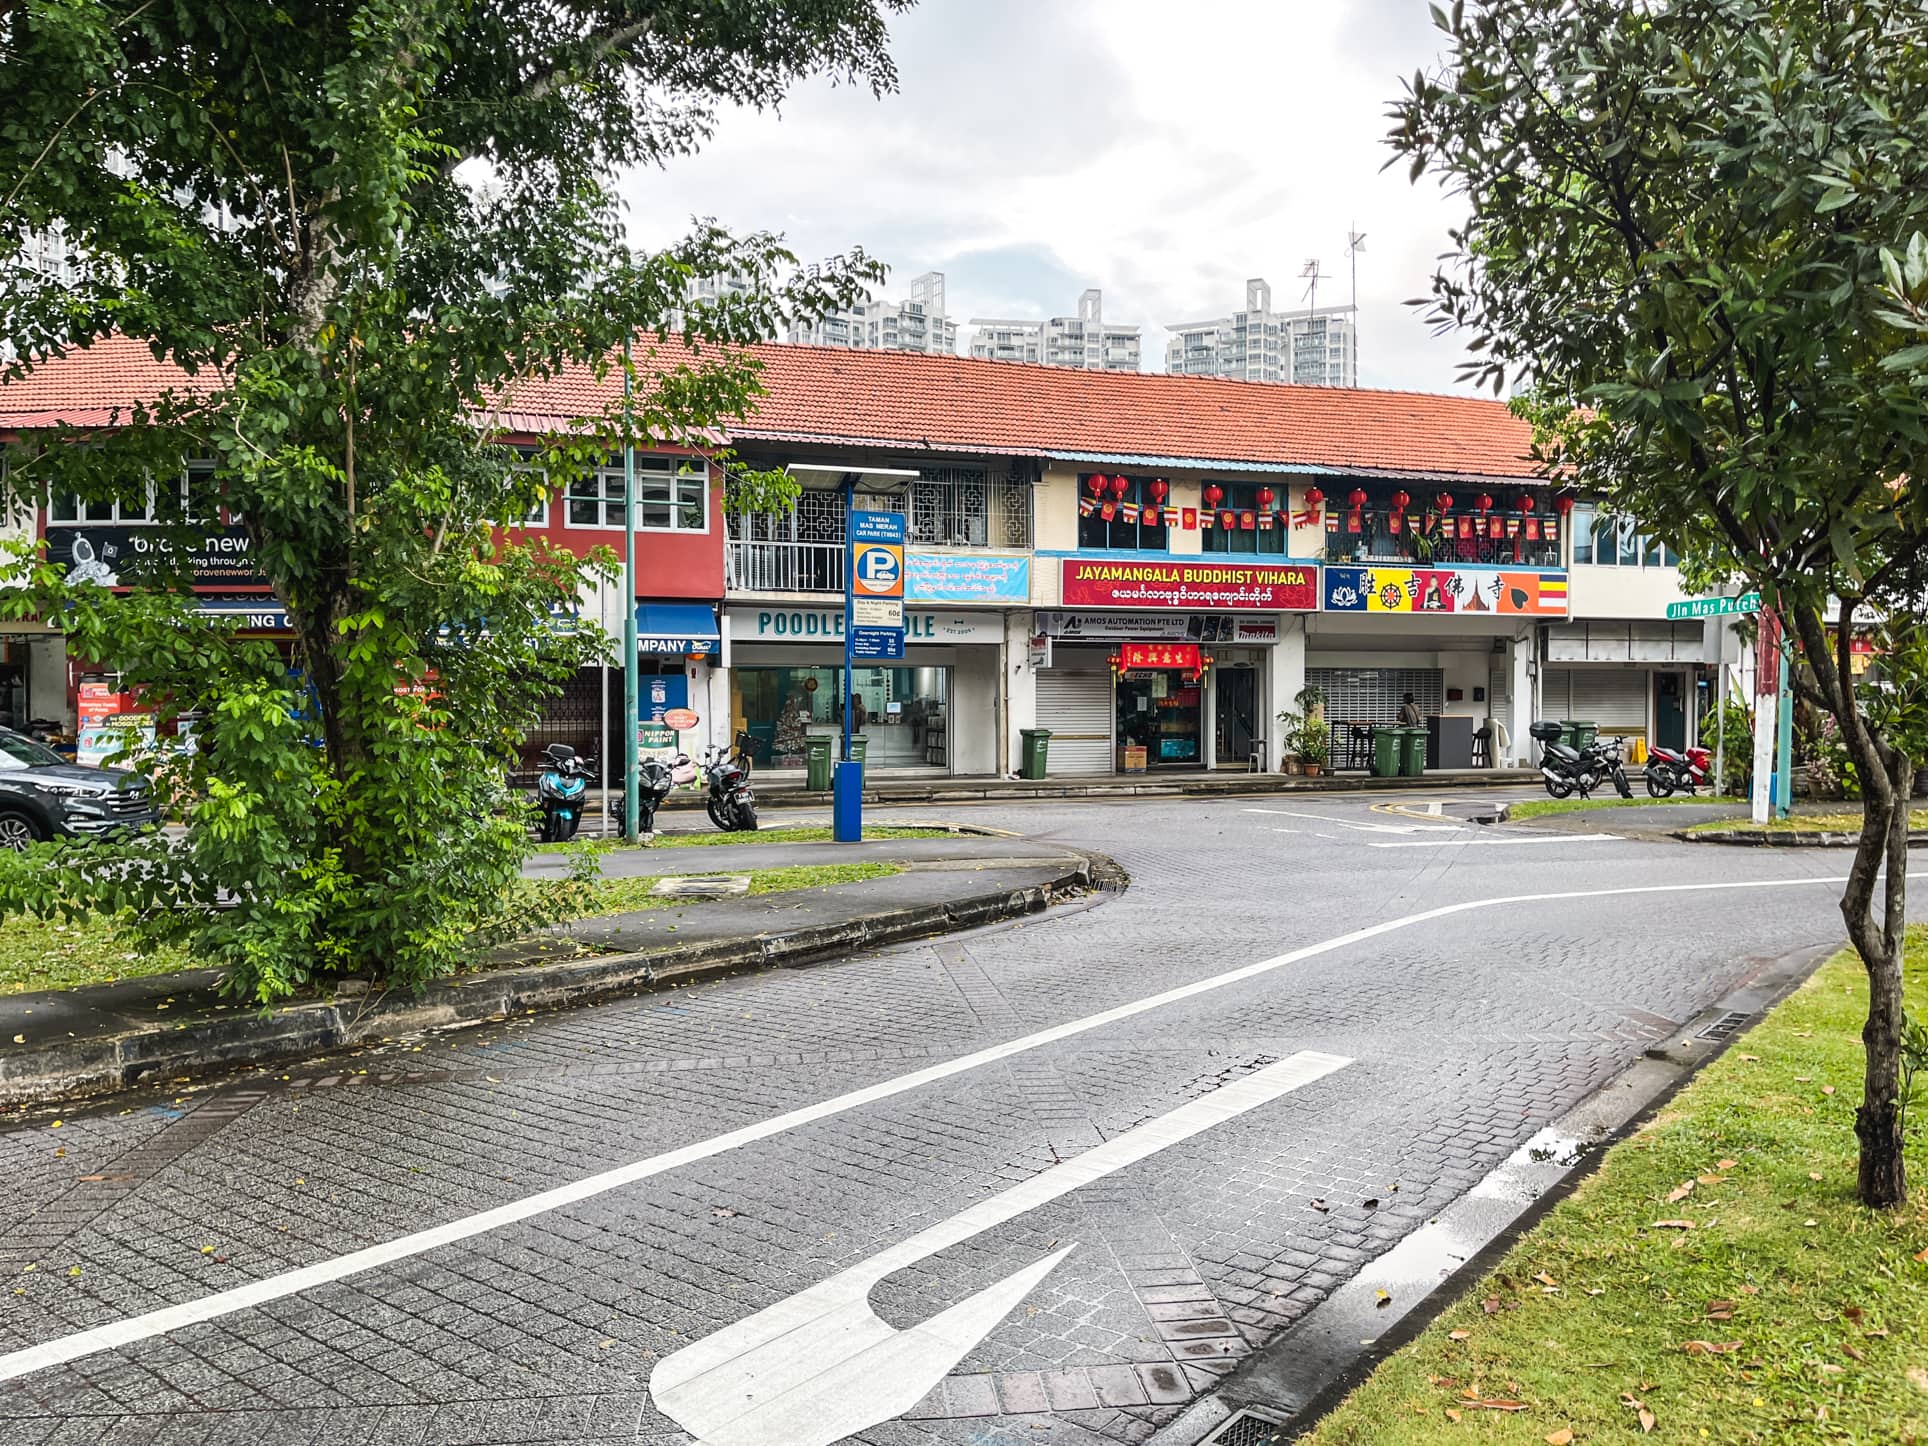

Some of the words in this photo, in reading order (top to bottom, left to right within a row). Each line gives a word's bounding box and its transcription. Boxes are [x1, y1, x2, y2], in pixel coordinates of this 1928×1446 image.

[206, 538, 249, 553] new
[867, 551, 896, 579] P
[1075, 565, 1180, 583] JAYAMANGALA
[1184, 568, 1252, 584] BUDDHIST
[1256, 570, 1306, 585] VIHARA
[1691, 602, 1714, 616] Mas
[760, 613, 845, 638] POODLE
[1084, 617, 1106, 625] AMOS
[1107, 617, 1156, 626] AUTOMATION
[1157, 618, 1171, 626] PTE
[1171, 618, 1185, 626] LTD
